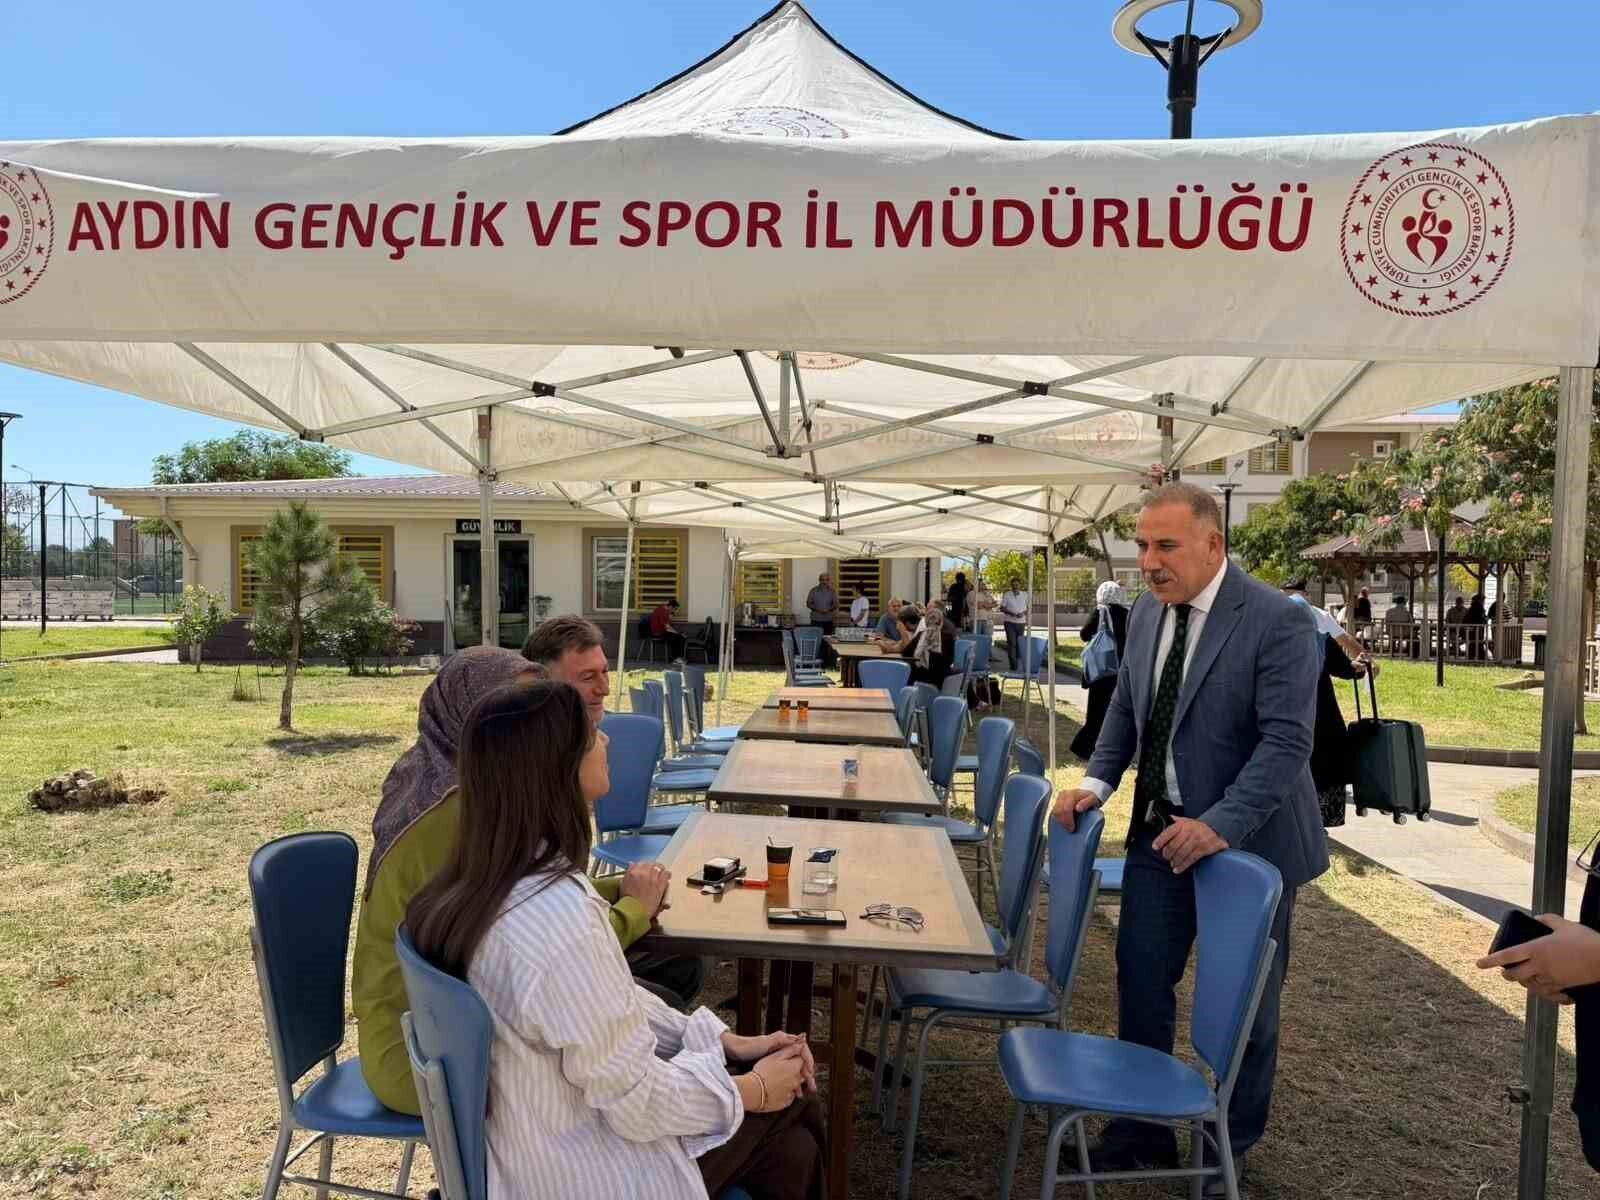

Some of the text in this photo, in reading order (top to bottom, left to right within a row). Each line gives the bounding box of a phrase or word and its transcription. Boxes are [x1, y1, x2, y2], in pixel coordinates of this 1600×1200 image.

[68, 182, 1313, 260] AYDIN GENÇLİK VE SPOR İL MÜDÜRLÜĞÜ
[1373, 171, 1482, 283] TÜRKİYE CUMHURİYETİ GENÇLİK VE SPOR BAKANLIĞI
